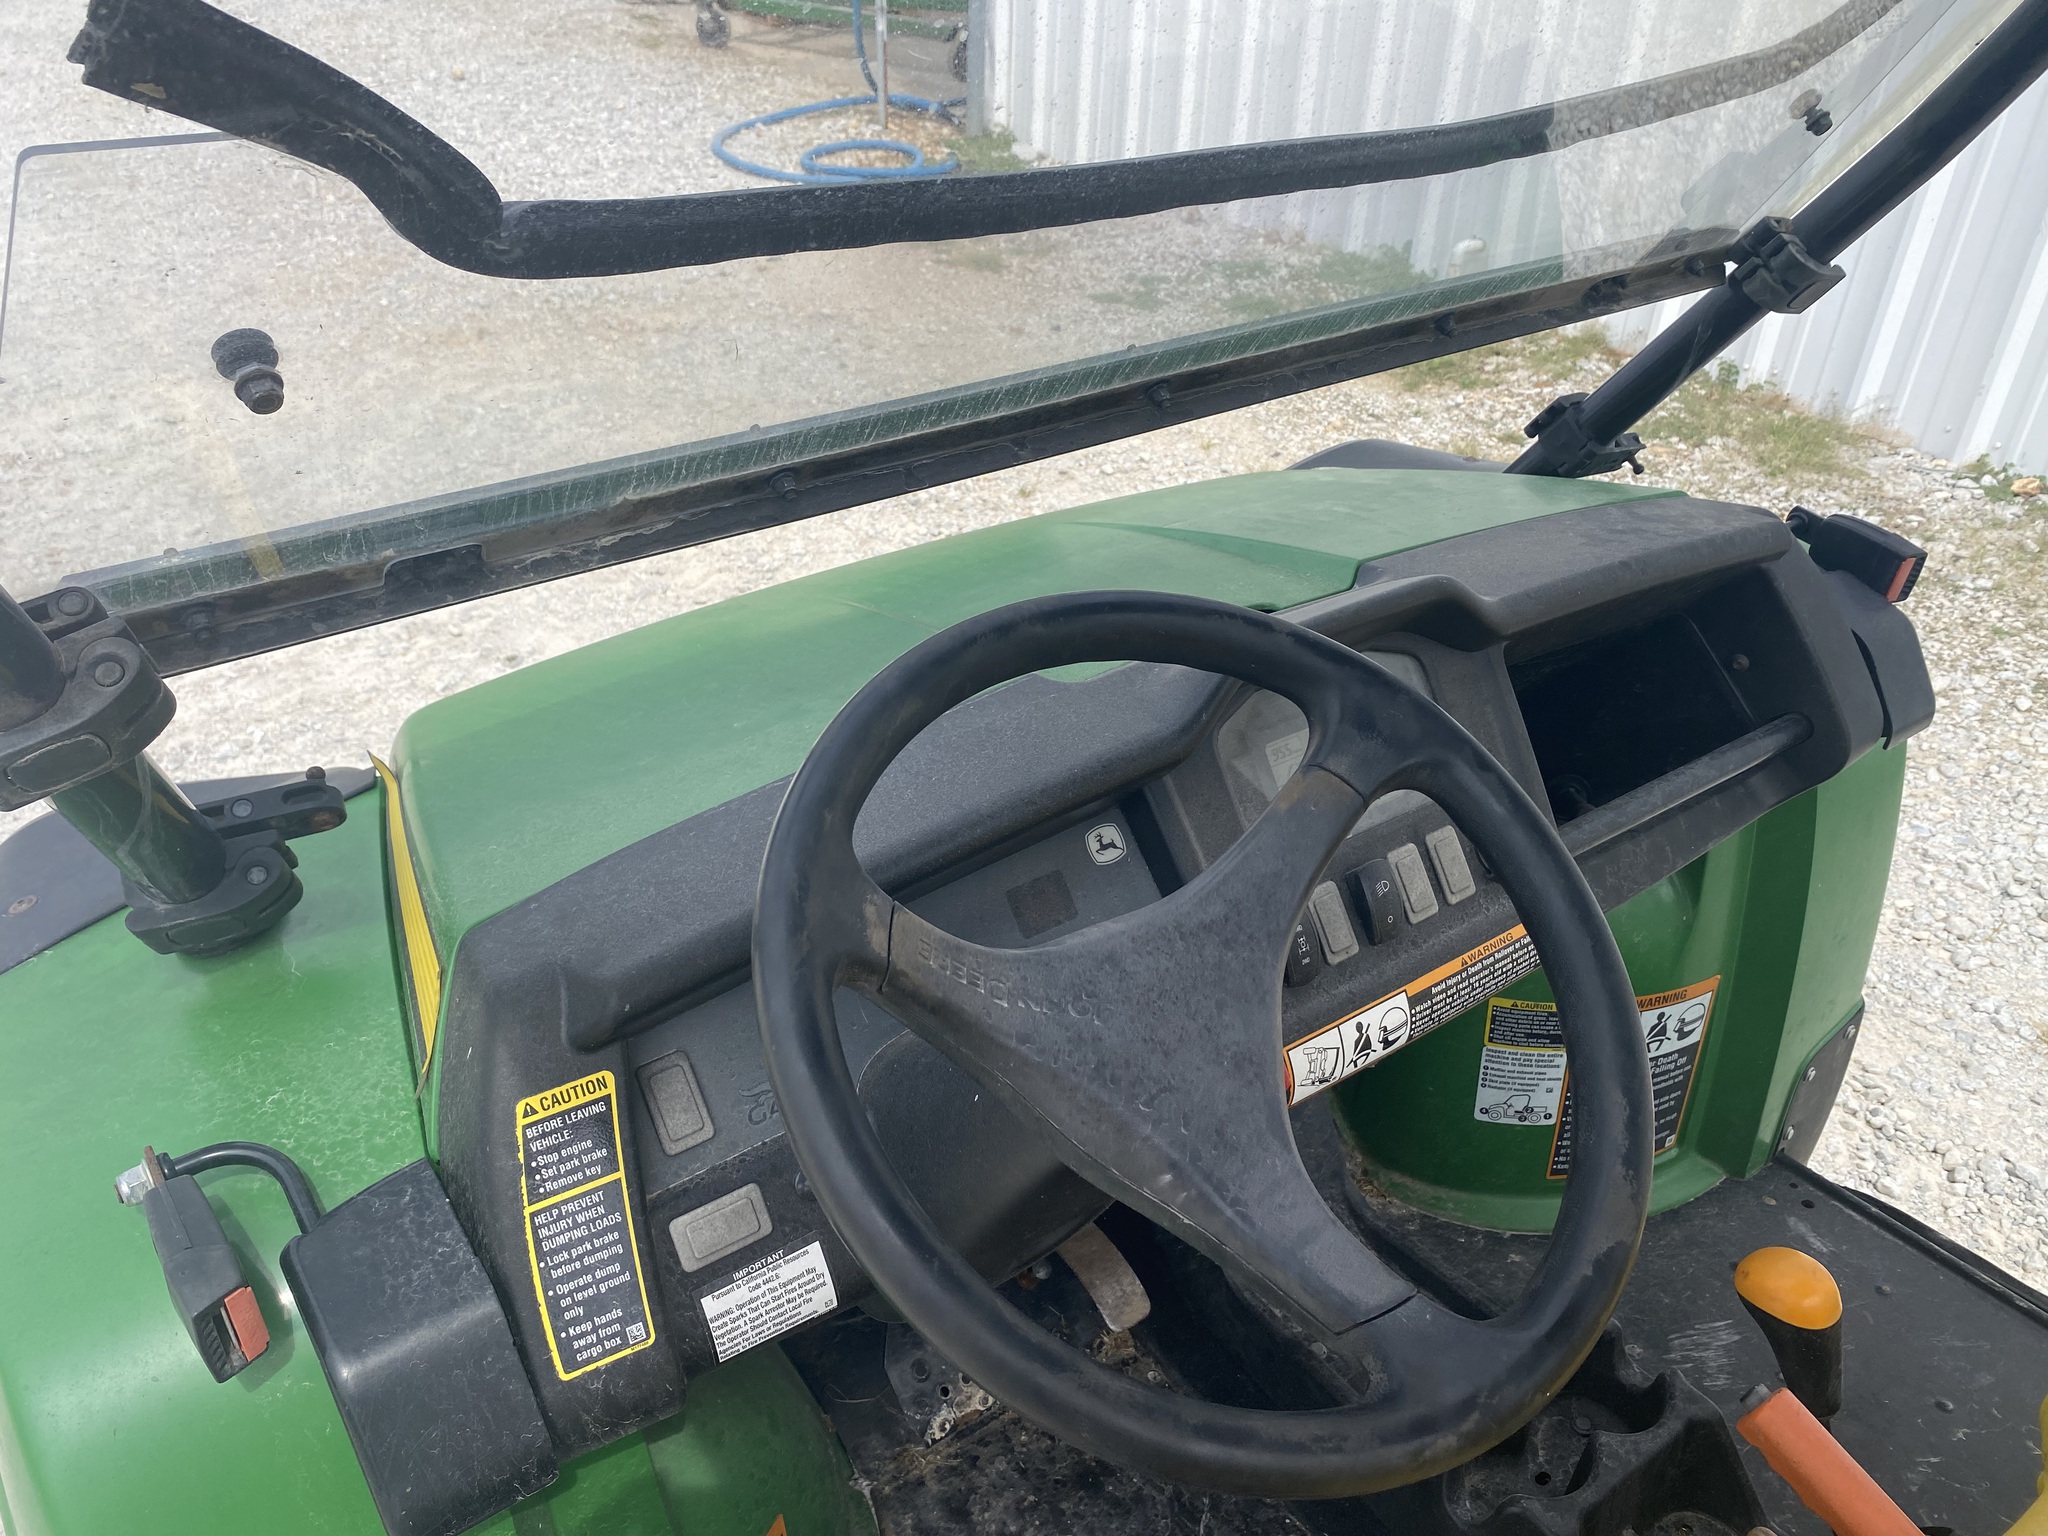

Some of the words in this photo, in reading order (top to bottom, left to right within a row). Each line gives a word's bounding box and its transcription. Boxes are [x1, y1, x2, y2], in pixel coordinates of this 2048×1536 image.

[1468, 933, 1513, 961] WARNING
[1520, 1002, 1552, 1010] CAUTION
[1637, 990, 1687, 1009] WARNING
[540, 1076, 607, 1110] CAUTION
[526, 1117, 563, 1138] BEFORE
[565, 1101, 605, 1123] LEAVING
[529, 1129, 573, 1151] VEHICLE:
[537, 1152, 558, 1165] Stop
[561, 1139, 592, 1156] engine
[541, 1165, 557, 1178] Set
[559, 1157, 580, 1174] park
[581, 1148, 607, 1163] brake
[545, 1171, 583, 1191] Remove
[584, 1164, 600, 1176] key
[534, 1208, 558, 1225] HELP
[561, 1190, 603, 1215] PREVENT
[538, 1217, 572, 1238] INJURY
[575, 1205, 604, 1223] WHEN
[542, 1226, 588, 1250] DUMPING
[590, 1212, 621, 1232] LOADS
[546, 1250, 569, 1265] Lock
[571, 1241, 592, 1258] park
[593, 1231, 618, 1247] brake
[550, 1261, 580, 1278] before
[583, 1244, 622, 1265] dumping
[733, 1249, 783, 1280] IMPORTANT
[556, 1274, 592, 1294] Operate
[595, 1263, 620, 1278] dump
[560, 1296, 571, 1307] on
[573, 1284, 596, 1301] level
[599, 1271, 630, 1293] ground
[711, 1285, 735, 1301] Pursuant
[741, 1270, 766, 1286] California
[766, 1262, 782, 1273] Public
[783, 1249, 809, 1265] Resources
[747, 1282, 761, 1292] Code
[762, 1272, 780, 1285] 4442.6:
[709, 1307, 734, 1324] WARNING:
[735, 1295, 760, 1311] Operation
[760, 1290, 766, 1298] of
[767, 1285, 778, 1294] This
[778, 1271, 805, 1289] Equipment
[805, 1266, 816, 1275] May
[711, 1321, 728, 1332] Create
[728, 1311, 747, 1324] Sparks
[747, 1304, 760, 1314] That
[759, 1299, 771, 1308] Can
[770, 1292, 784, 1303] Start
[783, 1286, 797, 1296] Fires
[797, 1275, 815, 1289] Around
[815, 1272, 824, 1280] Dry
[714, 1324, 742, 1340] Vegetation.
[748, 1312, 763, 1324] Spark
[764, 1301, 784, 1315] Arrestor
[785, 1296, 796, 1304] May
[804, 1280, 826, 1295] Required.
[564, 1306, 583, 1319] only
[568, 1321, 592, 1336] Keep
[593, 1308, 622, 1325] hands
[716, 1340, 726, 1348] The
[726, 1328, 748, 1343] Operator
[749, 1318, 768, 1331] Should
[768, 1308, 788, 1322] Contact
[788, 1301, 802, 1312] Local
[802, 1296, 812, 1305] Fire
[572, 1333, 596, 1348] away
[598, 1323, 620, 1337] from
[576, 1344, 602, 1360] cargo
[604, 1336, 621, 1349] box
[719, 1341, 741, 1355] Agencies
[741, 1335, 750, 1343] For
[751, 1329, 765, 1338] Laws
[772, 1311, 801, 1328] Regulations
[720, 1348, 740, 1360] Relating
[758, 1326, 784, 1341] Prevention
